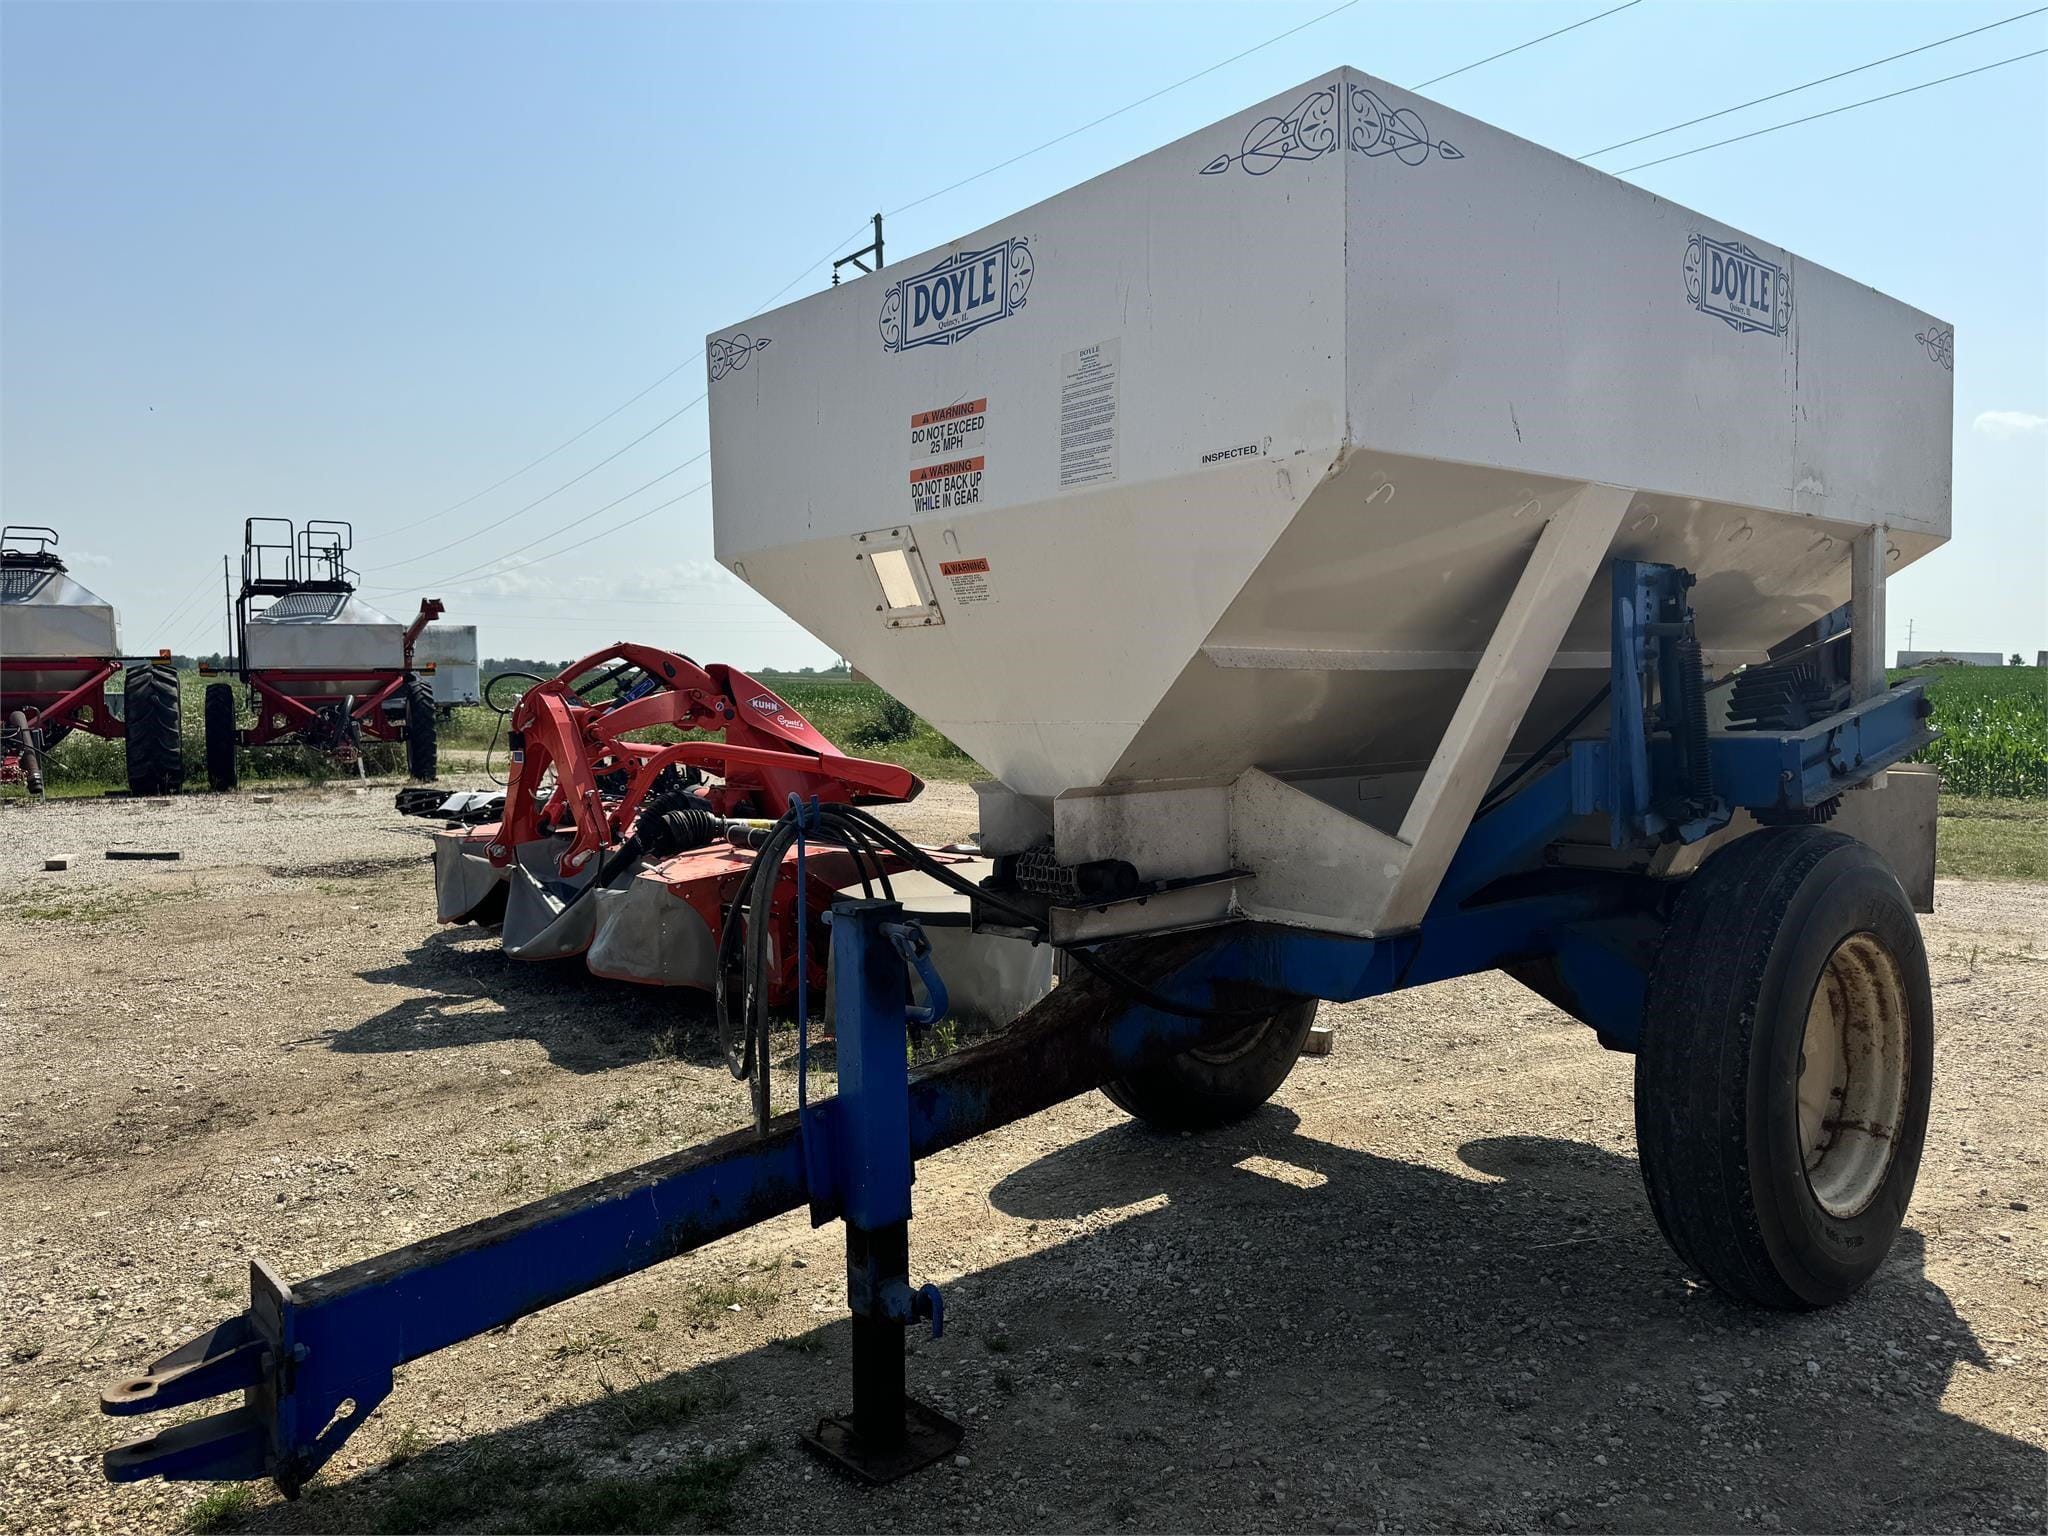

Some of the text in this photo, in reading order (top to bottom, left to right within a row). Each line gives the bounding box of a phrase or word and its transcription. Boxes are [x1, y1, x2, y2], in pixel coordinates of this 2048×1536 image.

[1711, 250, 1769, 313] DOYLE
[912, 257, 996, 328] DOYLE
[932, 402, 974, 420] WARNING
[912, 416, 984, 444] DO NOT EXCEED
[930, 435, 963, 454] 25 MPH
[1202, 445, 1257, 463] INSPECTED
[929, 460, 972, 477] WARNING
[911, 471, 982, 498] DO NOT BACK UP
[914, 488, 979, 512] WHILE IN GEAR
[951, 561, 985, 573] WARNING
[752, 699, 778, 711] KUHN
